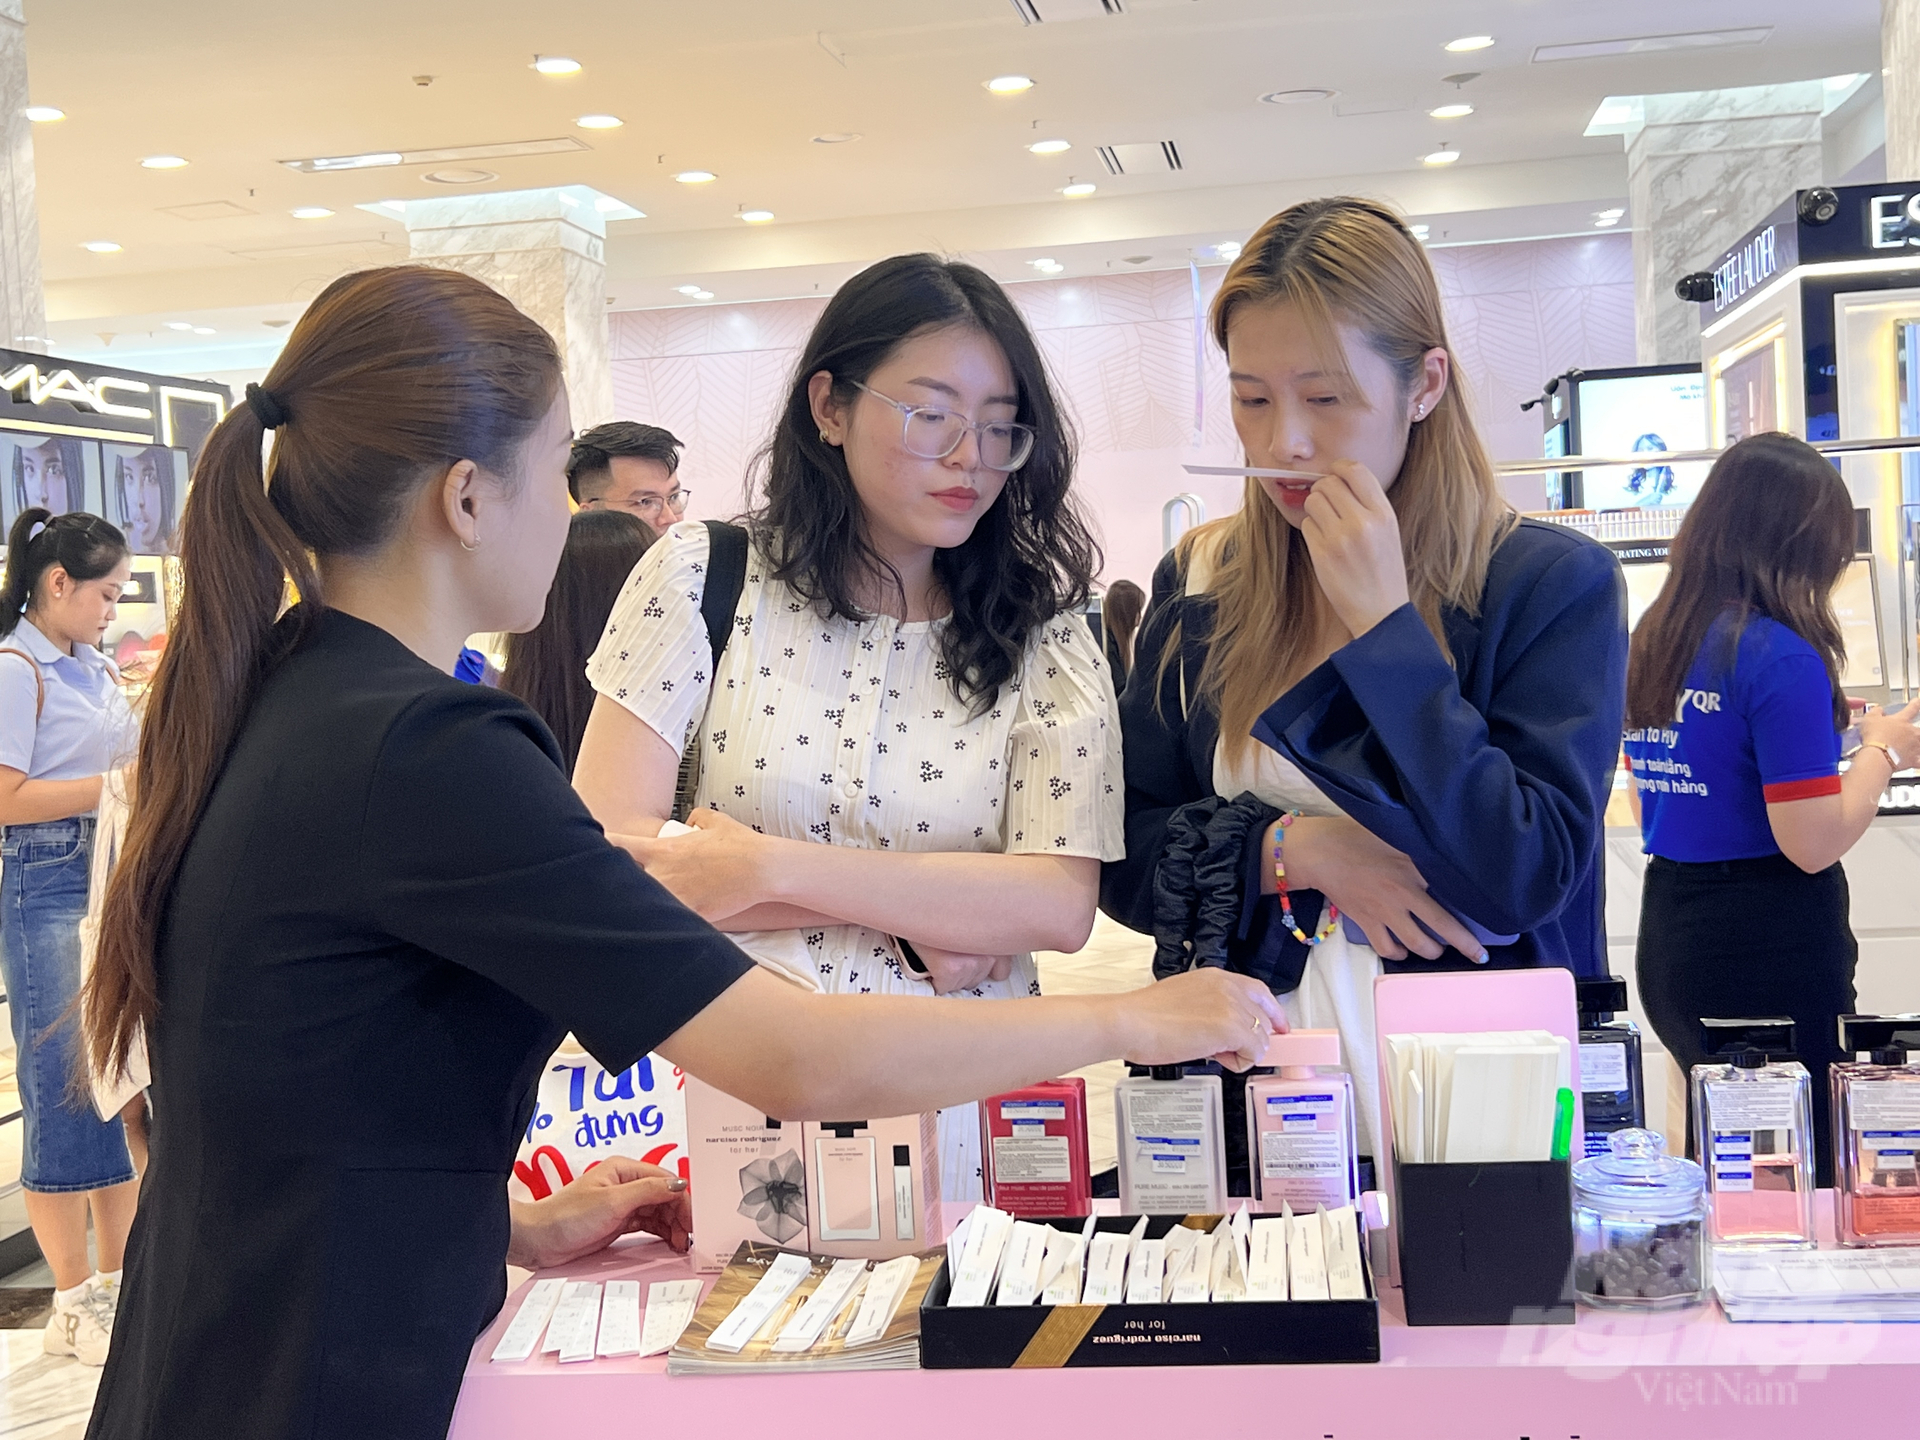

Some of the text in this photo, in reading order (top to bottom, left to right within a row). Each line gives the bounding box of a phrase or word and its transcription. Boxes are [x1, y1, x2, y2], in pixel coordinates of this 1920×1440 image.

[1737, 225, 1776, 295] LAUDER
[1613, 548, 1651, 559] RATING
[1647, 727, 1660, 743] to
[1672, 779, 1708, 797] hàng
[739, 1135, 782, 1143] rodriguez
[1123, 1319, 1166, 1331] for her
[1092, 1333, 1202, 1345] narciso rodriguez
